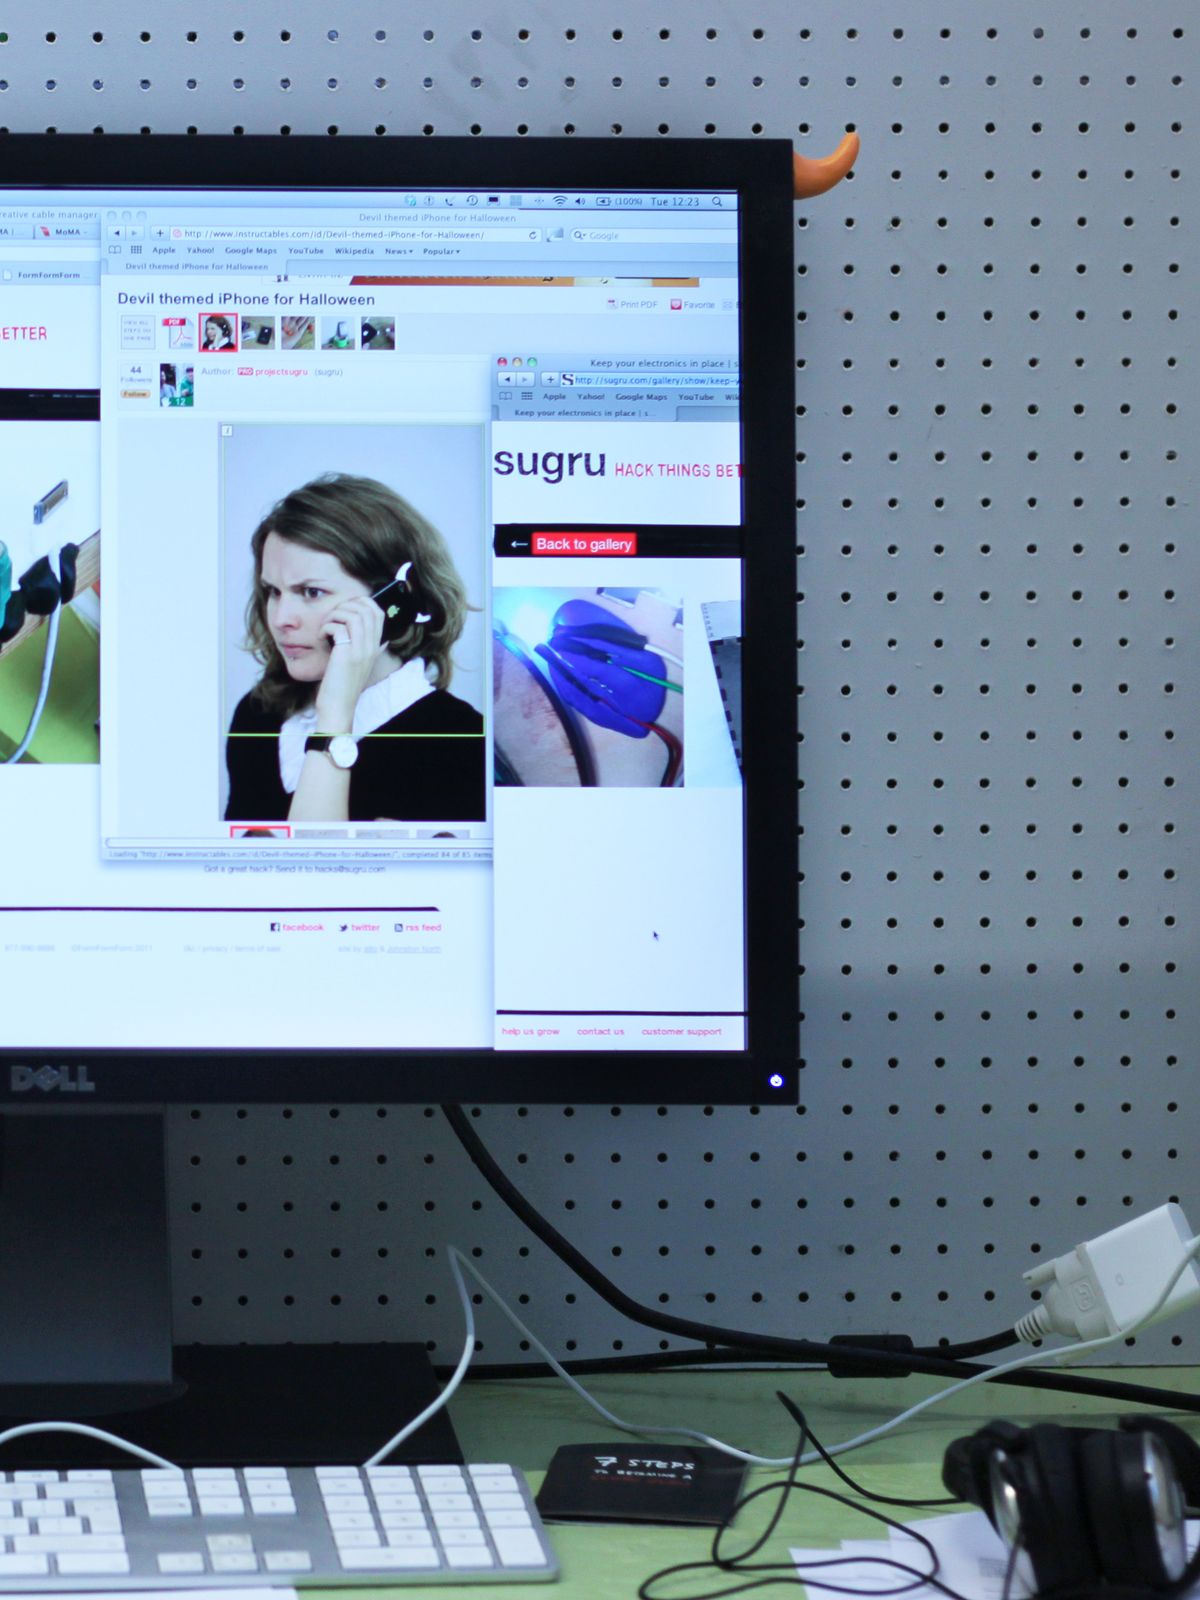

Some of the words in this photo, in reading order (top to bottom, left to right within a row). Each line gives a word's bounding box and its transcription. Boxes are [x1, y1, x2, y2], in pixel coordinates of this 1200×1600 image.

[651, 198, 668, 206] Tue
[672, 198, 700, 206] 12:23
[31, 211, 56, 219] cable
[58, 212, 98, 221] manager
[359, 214, 382, 222] Devil
[384, 214, 418, 222] themed
[421, 214, 450, 222] iPhone
[454, 214, 468, 222] for
[470, 214, 516, 222] Halloween
[152, 246, 176, 256] Apple
[224, 246, 254, 256] Google
[256, 247, 278, 256] Maps
[334, 247, 375, 256] Wikipedia
[423, 248, 454, 256] Popular
[18, 271, 80, 280] FormFormForm
[118, 292, 154, 305] Devil
[159, 292, 215, 305] themed
[218, 292, 270, 305] iPhone
[274, 292, 294, 305] for
[299, 292, 375, 306] Halloween
[590, 360, 614, 368] Keep
[616, 361, 636, 369] your
[638, 359, 688, 368] electronics
[690, 360, 698, 368] in
[700, 360, 725, 370] place
[201, 367, 234, 376] Author:
[255, 367, 309, 378] projectsugru
[314, 368, 344, 378] (sugru)
[493, 451, 606, 484] sugru
[614, 462, 654, 476] HACK
[659, 463, 711, 477] THINGS
[536, 538, 570, 550] Back
[573, 539, 587, 550] to
[590, 538, 632, 552] gallery
[10, 1064, 95, 1092] DELL
[594, 1456, 618, 1468] 7
[628, 1458, 696, 1470] STEPS
